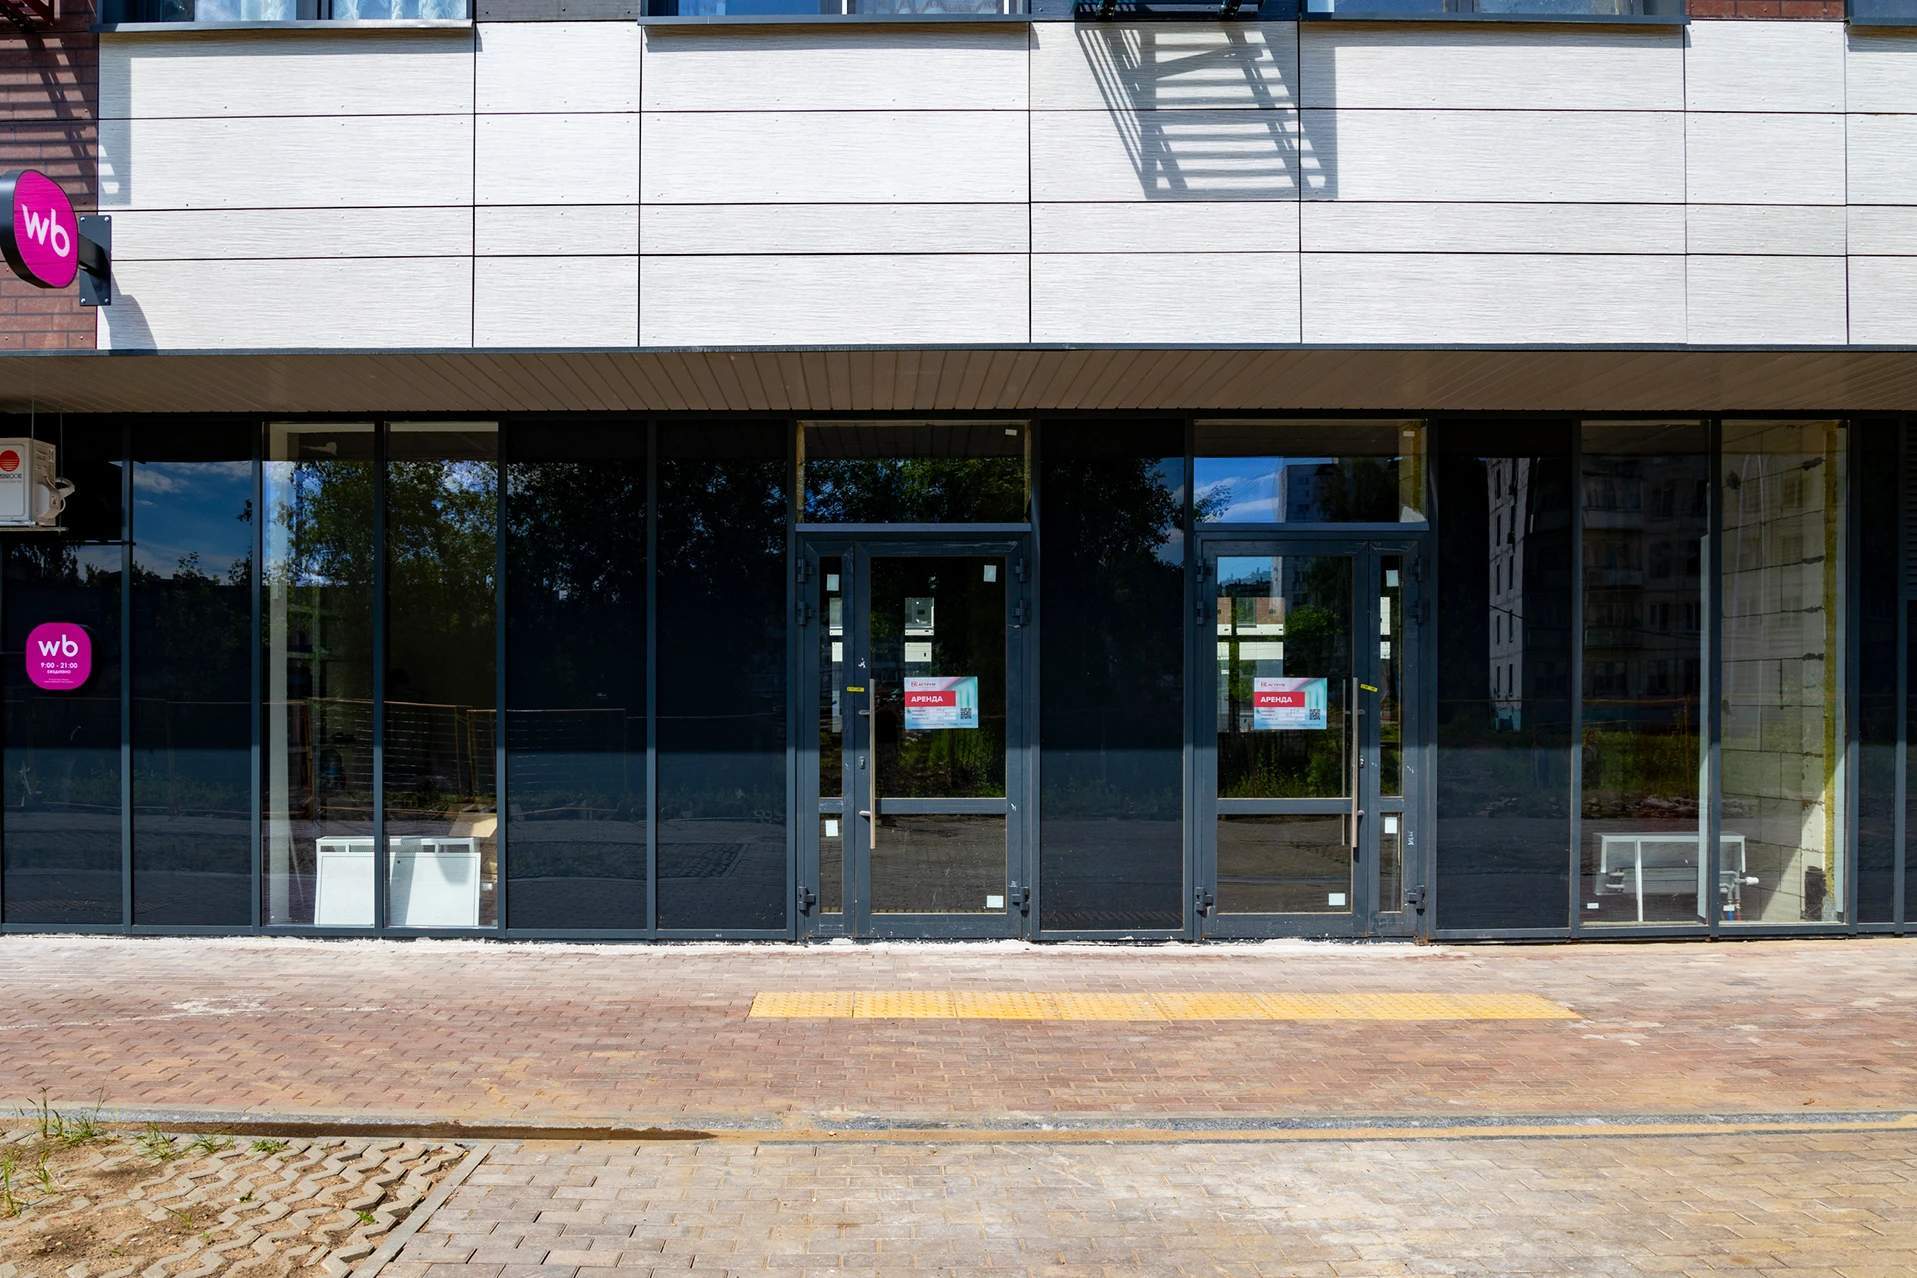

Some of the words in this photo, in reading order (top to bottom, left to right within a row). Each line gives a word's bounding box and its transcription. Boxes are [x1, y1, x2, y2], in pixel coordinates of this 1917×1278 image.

[38, 634, 79, 657] wb
[910, 695, 943, 703] АРЕНДА
[1260, 696, 1293, 704] АРЕНДА
